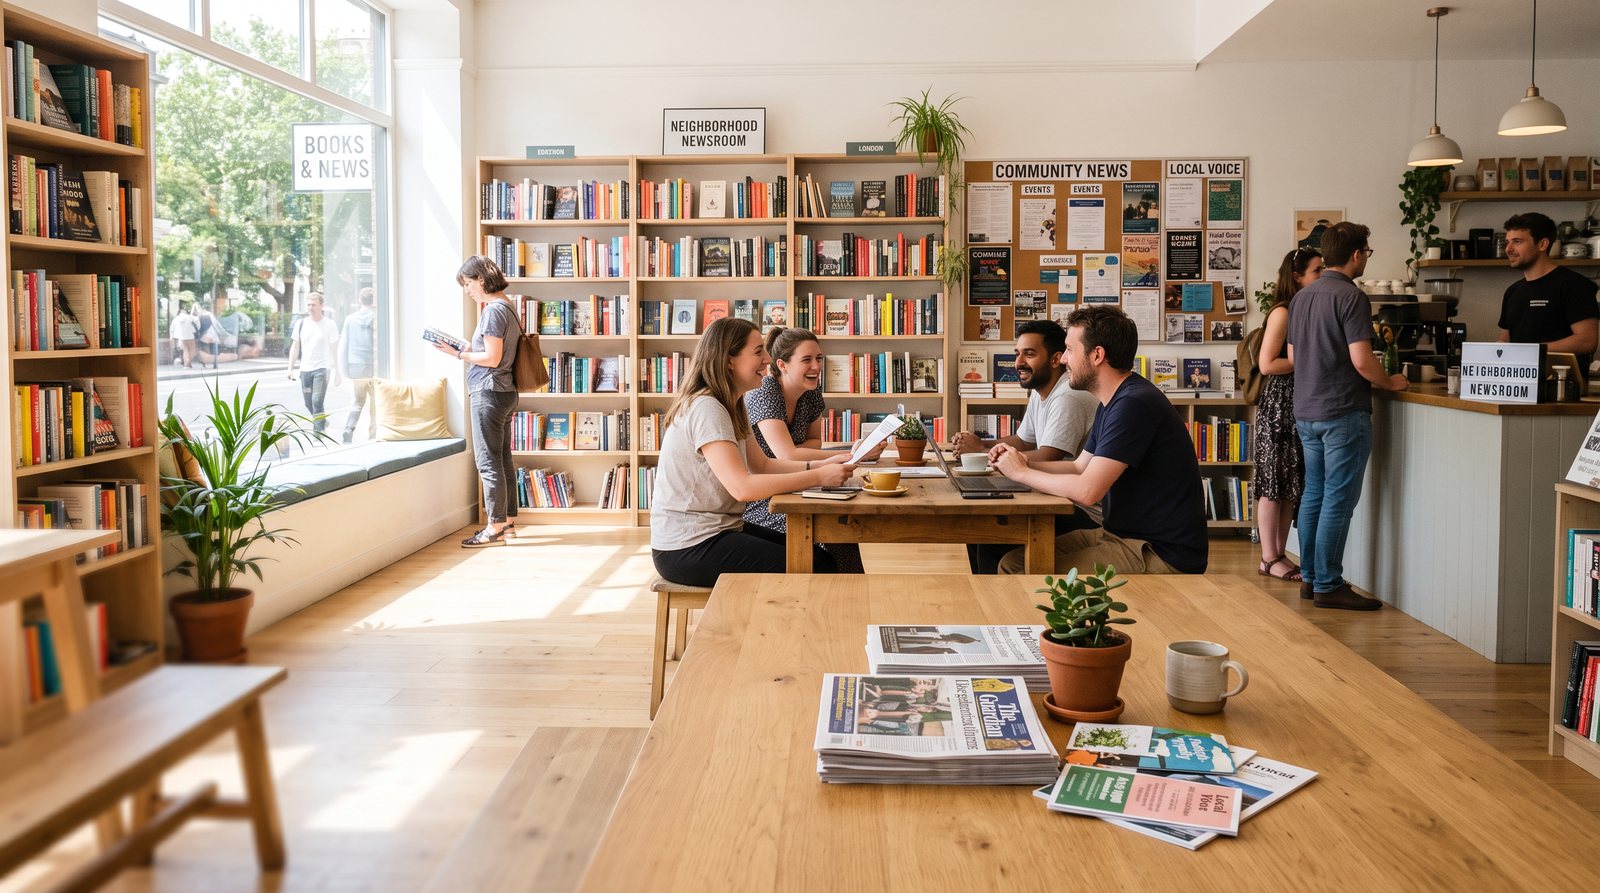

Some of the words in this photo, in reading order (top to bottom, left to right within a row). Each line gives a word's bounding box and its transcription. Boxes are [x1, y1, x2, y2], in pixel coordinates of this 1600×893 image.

[671, 120, 758, 132] NEIGHBORHOOD
[304, 135, 365, 154] BOOKS
[682, 135, 746, 147] NEWSROOM
[301, 160, 313, 178] &
[318, 159, 370, 178] NEWS
[996, 164, 1082, 178] COMMUNITY
[1087, 164, 1128, 178] NEWS
[1170, 164, 1205, 174] LOCAL
[1208, 164, 1240, 174] VOICE
[1462, 365, 1538, 379] NEIGHBORHOOD
[1470, 384, 1528, 398] NEWSROOM
[978, 694, 1006, 738] Guardian
[998, 703, 1017, 722] The
[1214, 794, 1228, 814] Local
